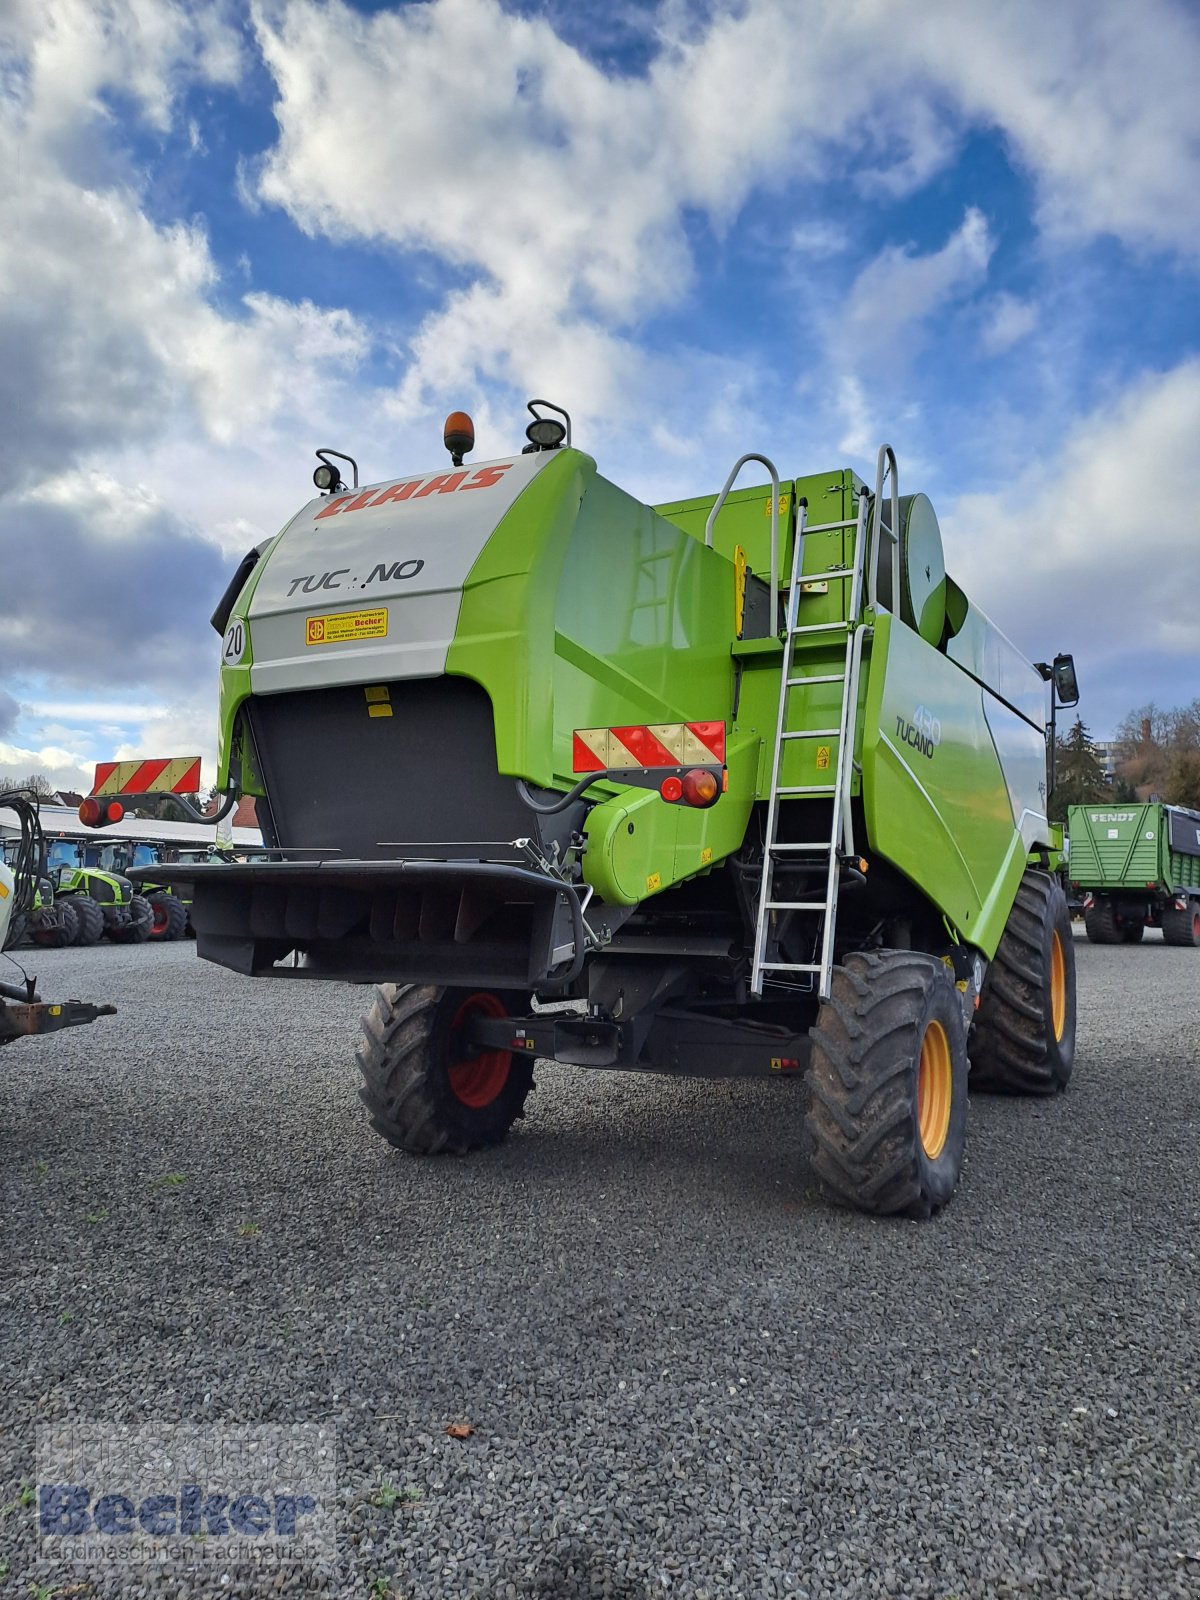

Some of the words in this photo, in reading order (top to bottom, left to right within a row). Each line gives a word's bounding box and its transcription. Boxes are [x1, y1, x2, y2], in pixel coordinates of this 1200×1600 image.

[314, 464, 514, 520] CLAAS
[287, 560, 425, 597] TUCNO
[354, 617, 382, 627] Becker
[225, 624, 242, 657] 20
[896, 715, 934, 759] TUCANO
[1091, 812, 1136, 822] FENDT
